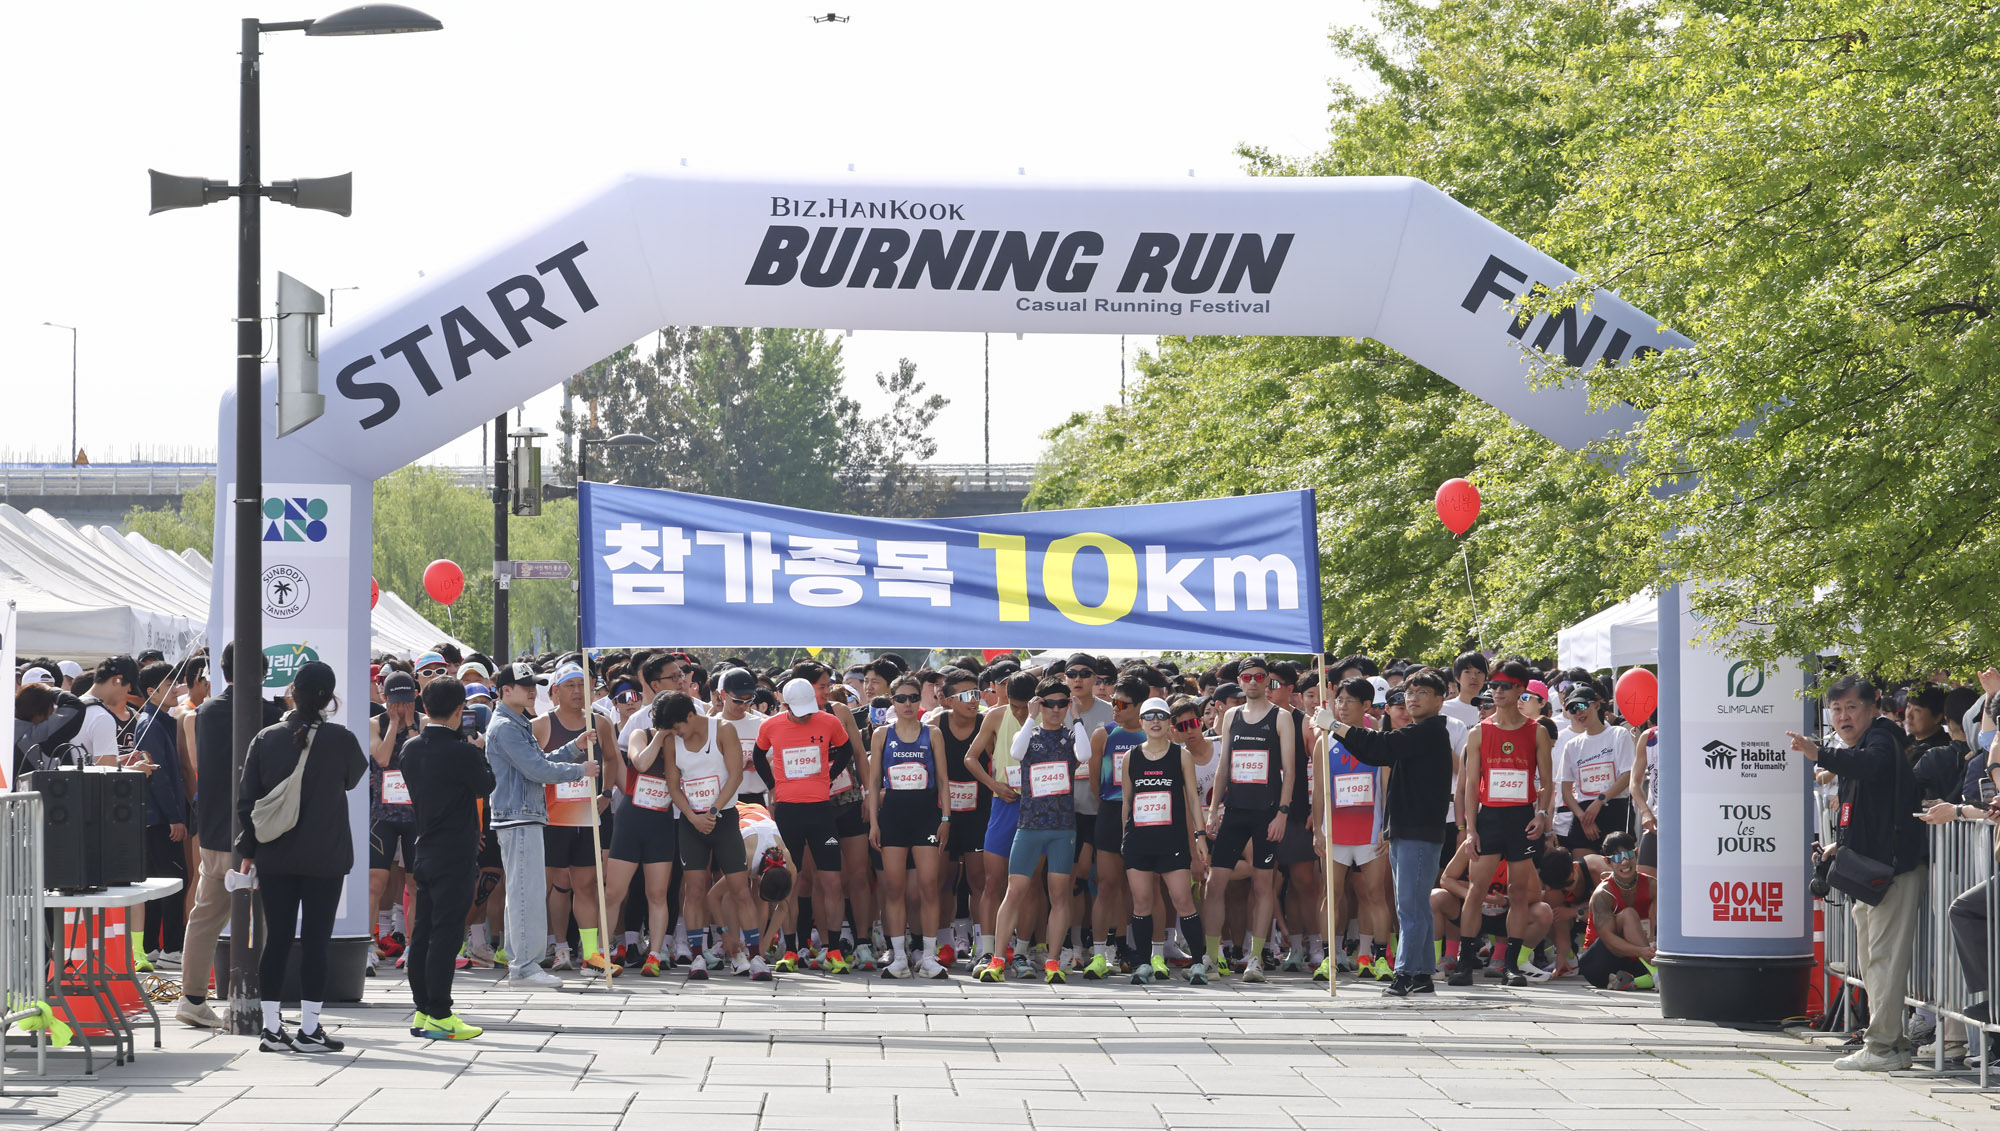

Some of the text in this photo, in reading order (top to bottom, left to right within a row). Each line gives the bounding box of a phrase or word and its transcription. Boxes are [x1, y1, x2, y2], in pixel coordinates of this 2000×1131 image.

[744, 225, 1295, 295] BURNING RUN
[1015, 297, 1270, 316] Casual Running Festival
[336, 240, 600, 431] START
[262, 567, 304, 584] SUNBODY
[603, 522, 1299, 626] 참가종목 10 km
[265, 603, 300, 617] TANNING
[1717, 704, 1775, 714] SLIMPLANET
[893, 751, 925, 759] DESCENTE
[1741, 748, 1786, 762] Habitat
[795, 756, 817, 766] 1994
[1241, 762, 1264, 770] 1955
[1741, 762, 1786, 772] for Humanity
[900, 773, 923, 782] 3434
[1041, 773, 1065, 783] 2449
[1135, 778, 1173, 787] SPOCARE
[1589, 773, 1611, 783] 3521
[1346, 784, 1370, 793] 1982
[1499, 780, 1524, 789] 2457
[645, 788, 670, 799] 3257
[695, 788, 715, 798] 1901
[950, 792, 973, 800] 2152
[1143, 803, 1167, 812] 3734
[1719, 804, 1772, 821] TOUS
[1737, 820, 1755, 836] les
[1717, 837, 1776, 856] JOURS
[1709, 881, 1783, 922] 일요신문
